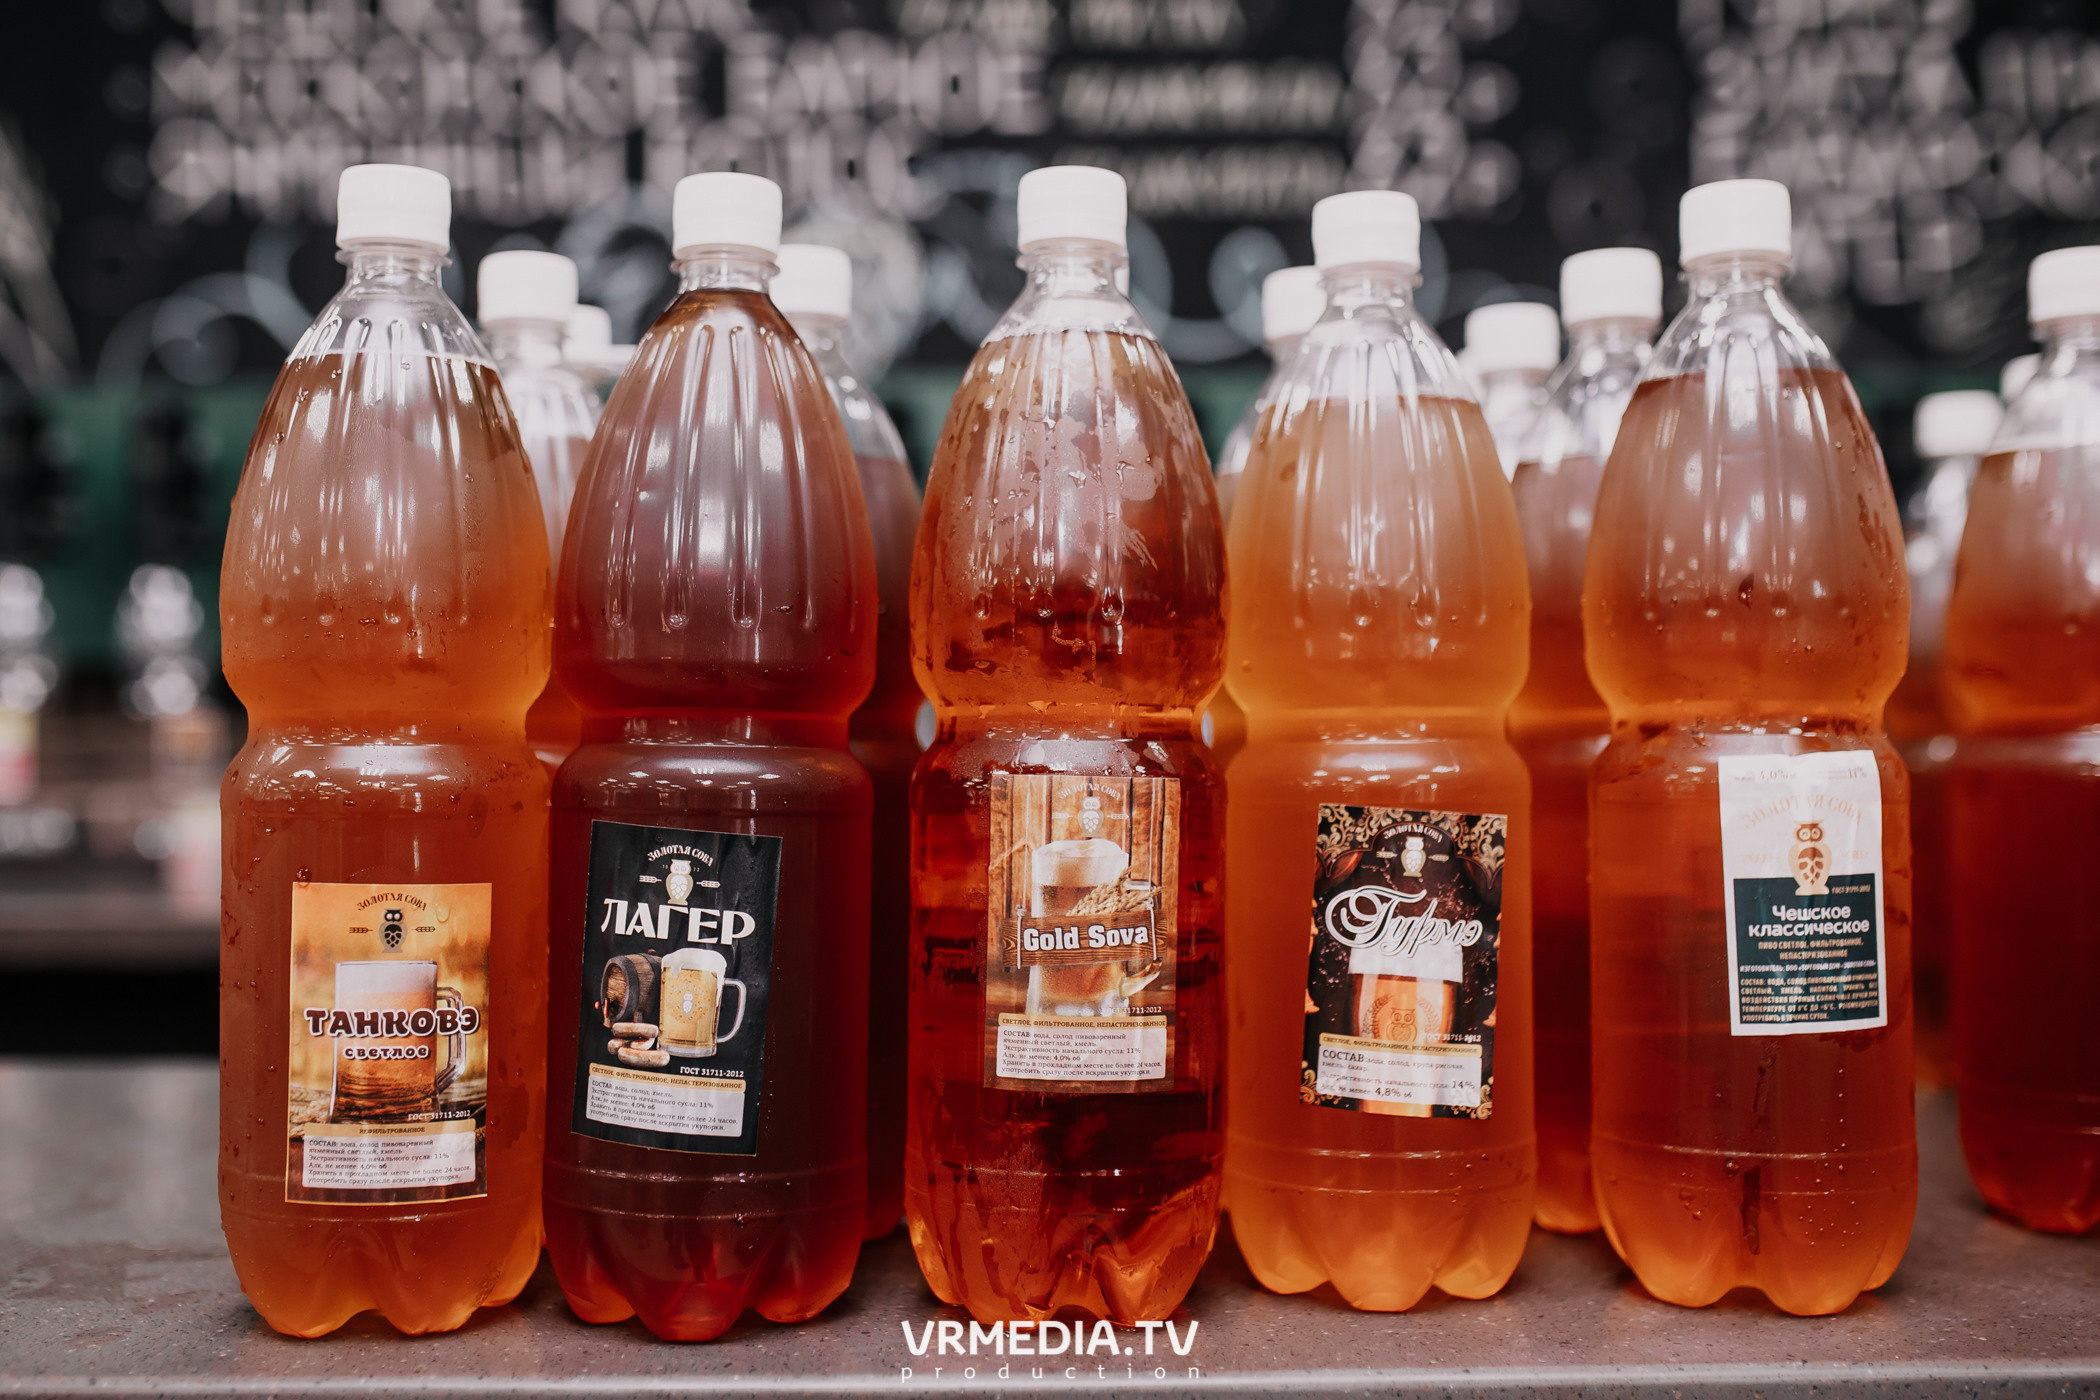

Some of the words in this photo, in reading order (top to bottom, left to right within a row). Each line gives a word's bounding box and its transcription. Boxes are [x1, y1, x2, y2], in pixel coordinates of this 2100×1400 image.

[1099, 784, 1121, 801] СОВА
[647, 844, 691, 862] ЗОЛОТАЯ
[691, 848, 714, 867] СОВА
[357, 892, 403, 911] ЗОЛОТАЯ
[404, 894, 427, 911] СОВА
[601, 898, 756, 945] ЛАГЕР
[1325, 884, 1483, 958] Гурмэ
[1772, 905, 1851, 922] Чешское
[1748, 919, 1870, 937] классическое
[1023, 926, 1080, 951] Gold
[1088, 925, 1149, 949] Sova
[1758, 941, 1778, 950] ПИВО
[304, 1006, 481, 1037] ТАНКОВЭ
[1096, 1020, 1165, 1028] НЕПАСТЕРИЗОВАННОЕ
[343, 1045, 429, 1059] светлое
[680, 1066, 700, 1075] ГОСТ
[701, 1068, 744, 1078] 31711-2012
[670, 1078, 743, 1089] НЕПАСТЕРИЗОВАННОЕ
[1375, 1087, 1401, 1098] 4,8%
[699, 1101, 714, 1109] 11%
[408, 1113, 427, 1121] ГОСТ
[430, 1110, 471, 1119] 31711-2012
